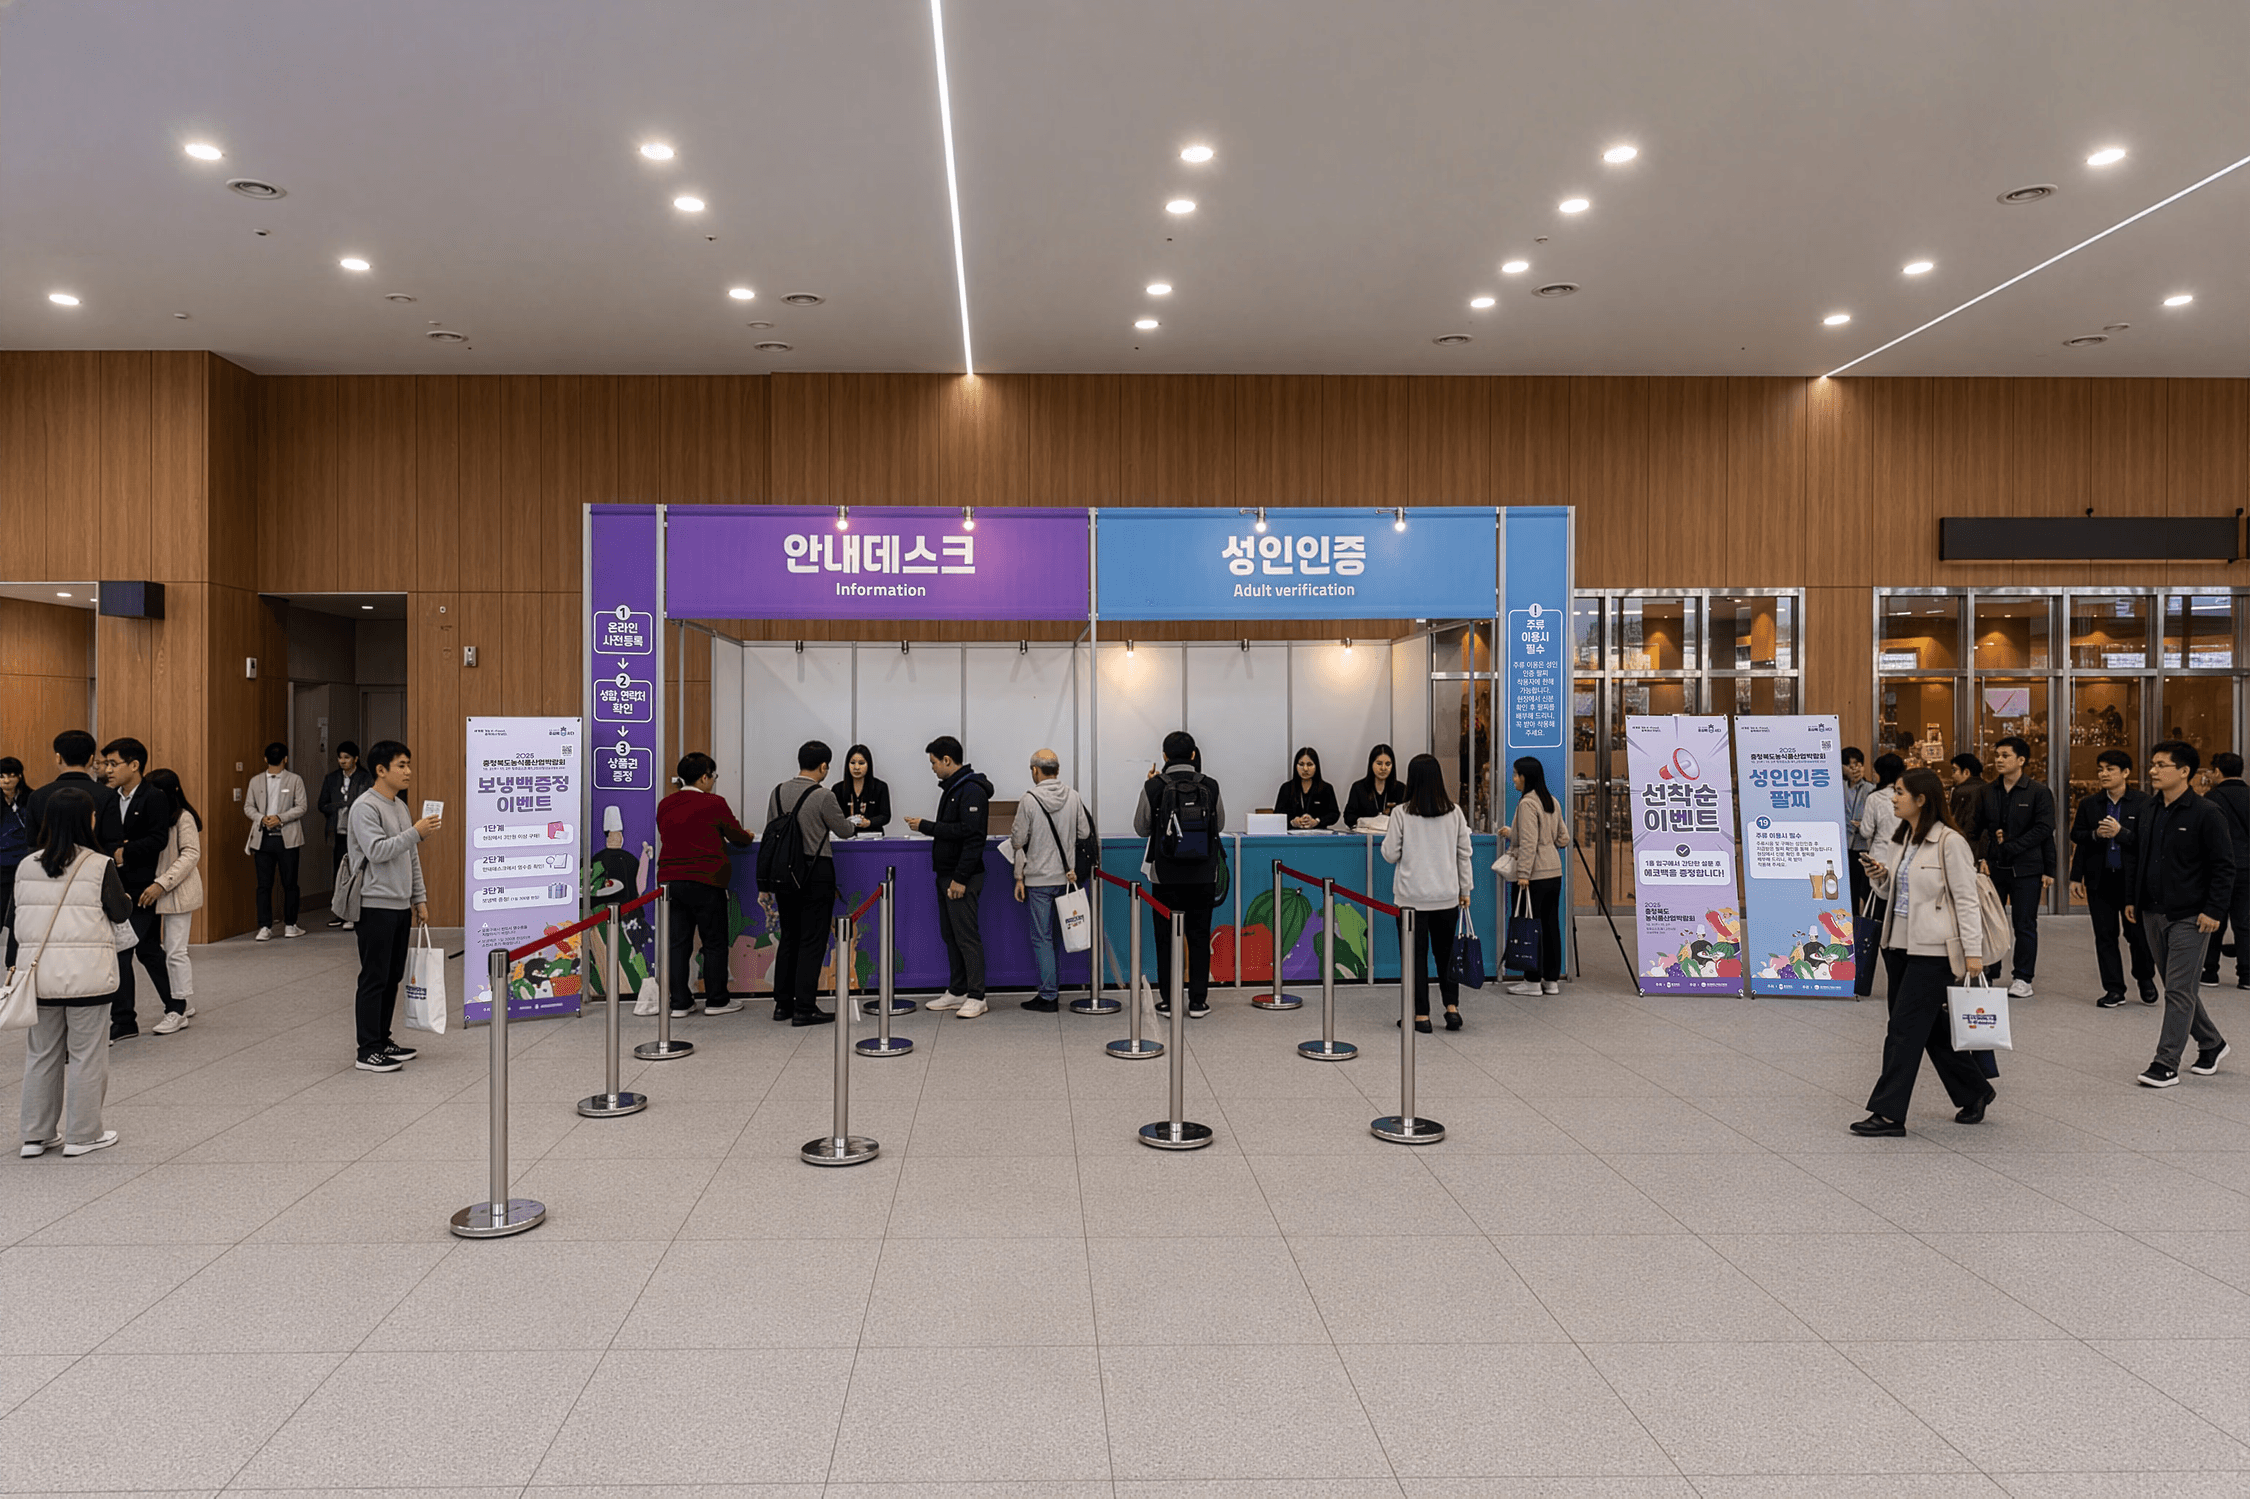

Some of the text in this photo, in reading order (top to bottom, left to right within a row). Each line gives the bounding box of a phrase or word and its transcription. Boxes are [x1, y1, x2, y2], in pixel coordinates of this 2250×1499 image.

[783, 534, 976, 574] 안내데스크
[1221, 535, 1366, 576] 성인인증
[836, 582, 926, 596] Information
[1234, 583, 1355, 597] Adult verification
[620, 608, 625, 618] 1
[608, 622, 638, 634] 온라인
[1526, 619, 1545, 630] 주류
[603, 635, 643, 647] 사전등록
[1521, 631, 1549, 642] 이용시
[1526, 643, 1545, 655] 필수
[1527, 661, 1544, 669] 이용은
[1546, 661, 1558, 669] 성인
[1523, 670, 1535, 678] 인증
[620, 676, 627, 686] 2
[600, 689, 646, 702] 성함, 연락처
[1517, 695, 1541, 703] 현장에서
[613, 703, 633, 715] 확인
[620, 743, 626, 753] 3
[607, 758, 638, 770] 상품권
[613, 770, 633, 783] 증정
[1749, 769, 1830, 787] 성인인증
[478, 775, 569, 794] 보냉백증정
[1643, 784, 1717, 807] 선착순
[1770, 791, 1810, 808] 팔찌
[497, 795, 552, 813] 이벤트
[1644, 809, 1719, 832] 이벤트
[483, 824, 504, 833] 1단계
[483, 856, 505, 864] 2단계
[1644, 869, 1725, 877] 에코백을 증정합니다!
[483, 887, 504, 895] 3단계
